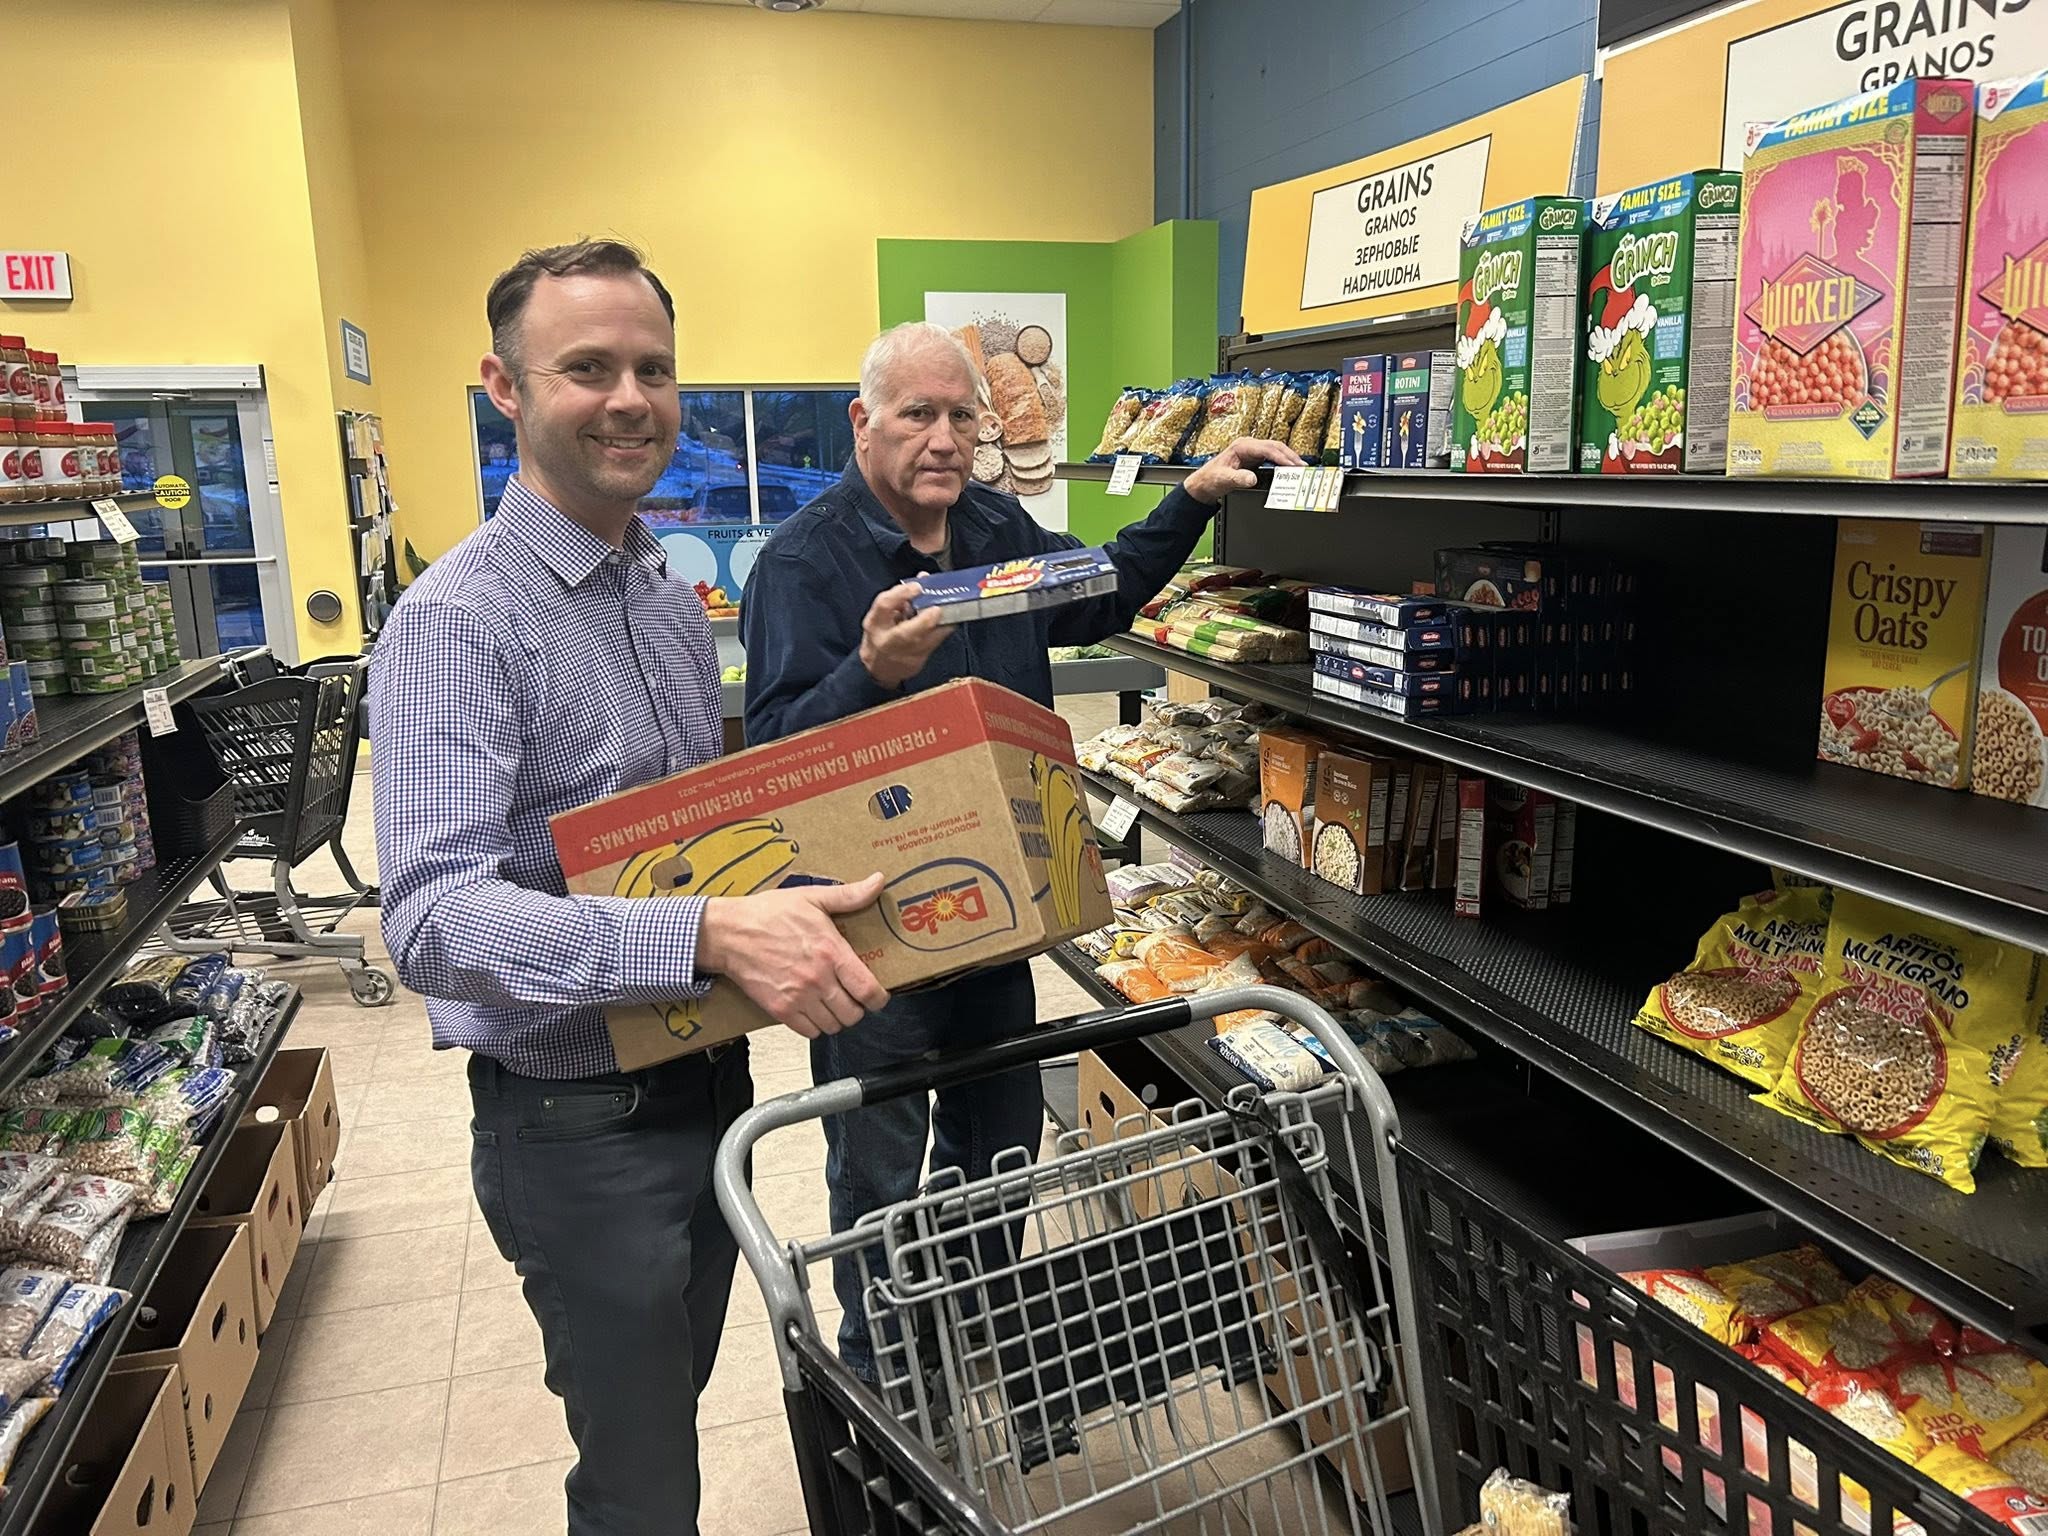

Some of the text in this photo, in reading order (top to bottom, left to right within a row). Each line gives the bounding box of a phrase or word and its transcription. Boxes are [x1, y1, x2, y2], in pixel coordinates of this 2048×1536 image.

[1836, 0, 2030, 61] GRAIN
[1847, 96, 1889, 122] SIZE
[1357, 163, 1434, 213] GRAINS
[1620, 181, 1681, 212] FAMILY SIZE
[1700, 185, 1736, 208] GRINCH
[1364, 206, 1417, 236] GRANOS
[1481, 204, 1525, 231] FAMILY SIZE
[1541, 209, 1575, 230] GRINCH
[1354, 234, 1420, 266] ЗЕРНОВЫЕ
[1612, 235, 1676, 289] GRINCH
[6, 255, 55, 291] EXIT
[1342, 262, 1421, 295] HADHUUDHA
[1475, 253, 1520, 301] GRINCH
[2003, 254, 2048, 318] WI
[1762, 275, 1856, 338] WICKED
[1348, 384, 1372, 394] RIGATE
[1349, 374, 1372, 385] PENNE
[1394, 376, 1420, 389] ROTINI
[1276, 472, 1300, 482] Family Size
[708, 529, 743, 539] FRUITS
[746, 528, 754, 537] &
[920, 585, 970, 596] PAGHETTI
[1847, 559, 1958, 619] Crispy
[1854, 603, 1929, 650] Oats
[2020, 625, 2048, 654] TO
[776, 754, 795, 767] Dole
[851, 726, 937, 767] PREMIUM
[717, 766, 756, 787] Company,
[755, 759, 776, 773] Food
[765, 748, 850, 797] BANANAS
[674, 783, 754, 828] PREMIUM
[677, 785, 699, 799] 2021
[949, 819, 982, 838] PRODUCT
[961, 809, 978, 821] NET
[590, 814, 669, 854] BANANAS
[896, 835, 934, 852] ECUADOR
[1874, 933, 1964, 980] ARITOS
[1842, 937, 1969, 1009] MULTIGRANO
[1860, 988, 1925, 1026] RINGS
[1922, 1412, 1963, 1431] OATS
